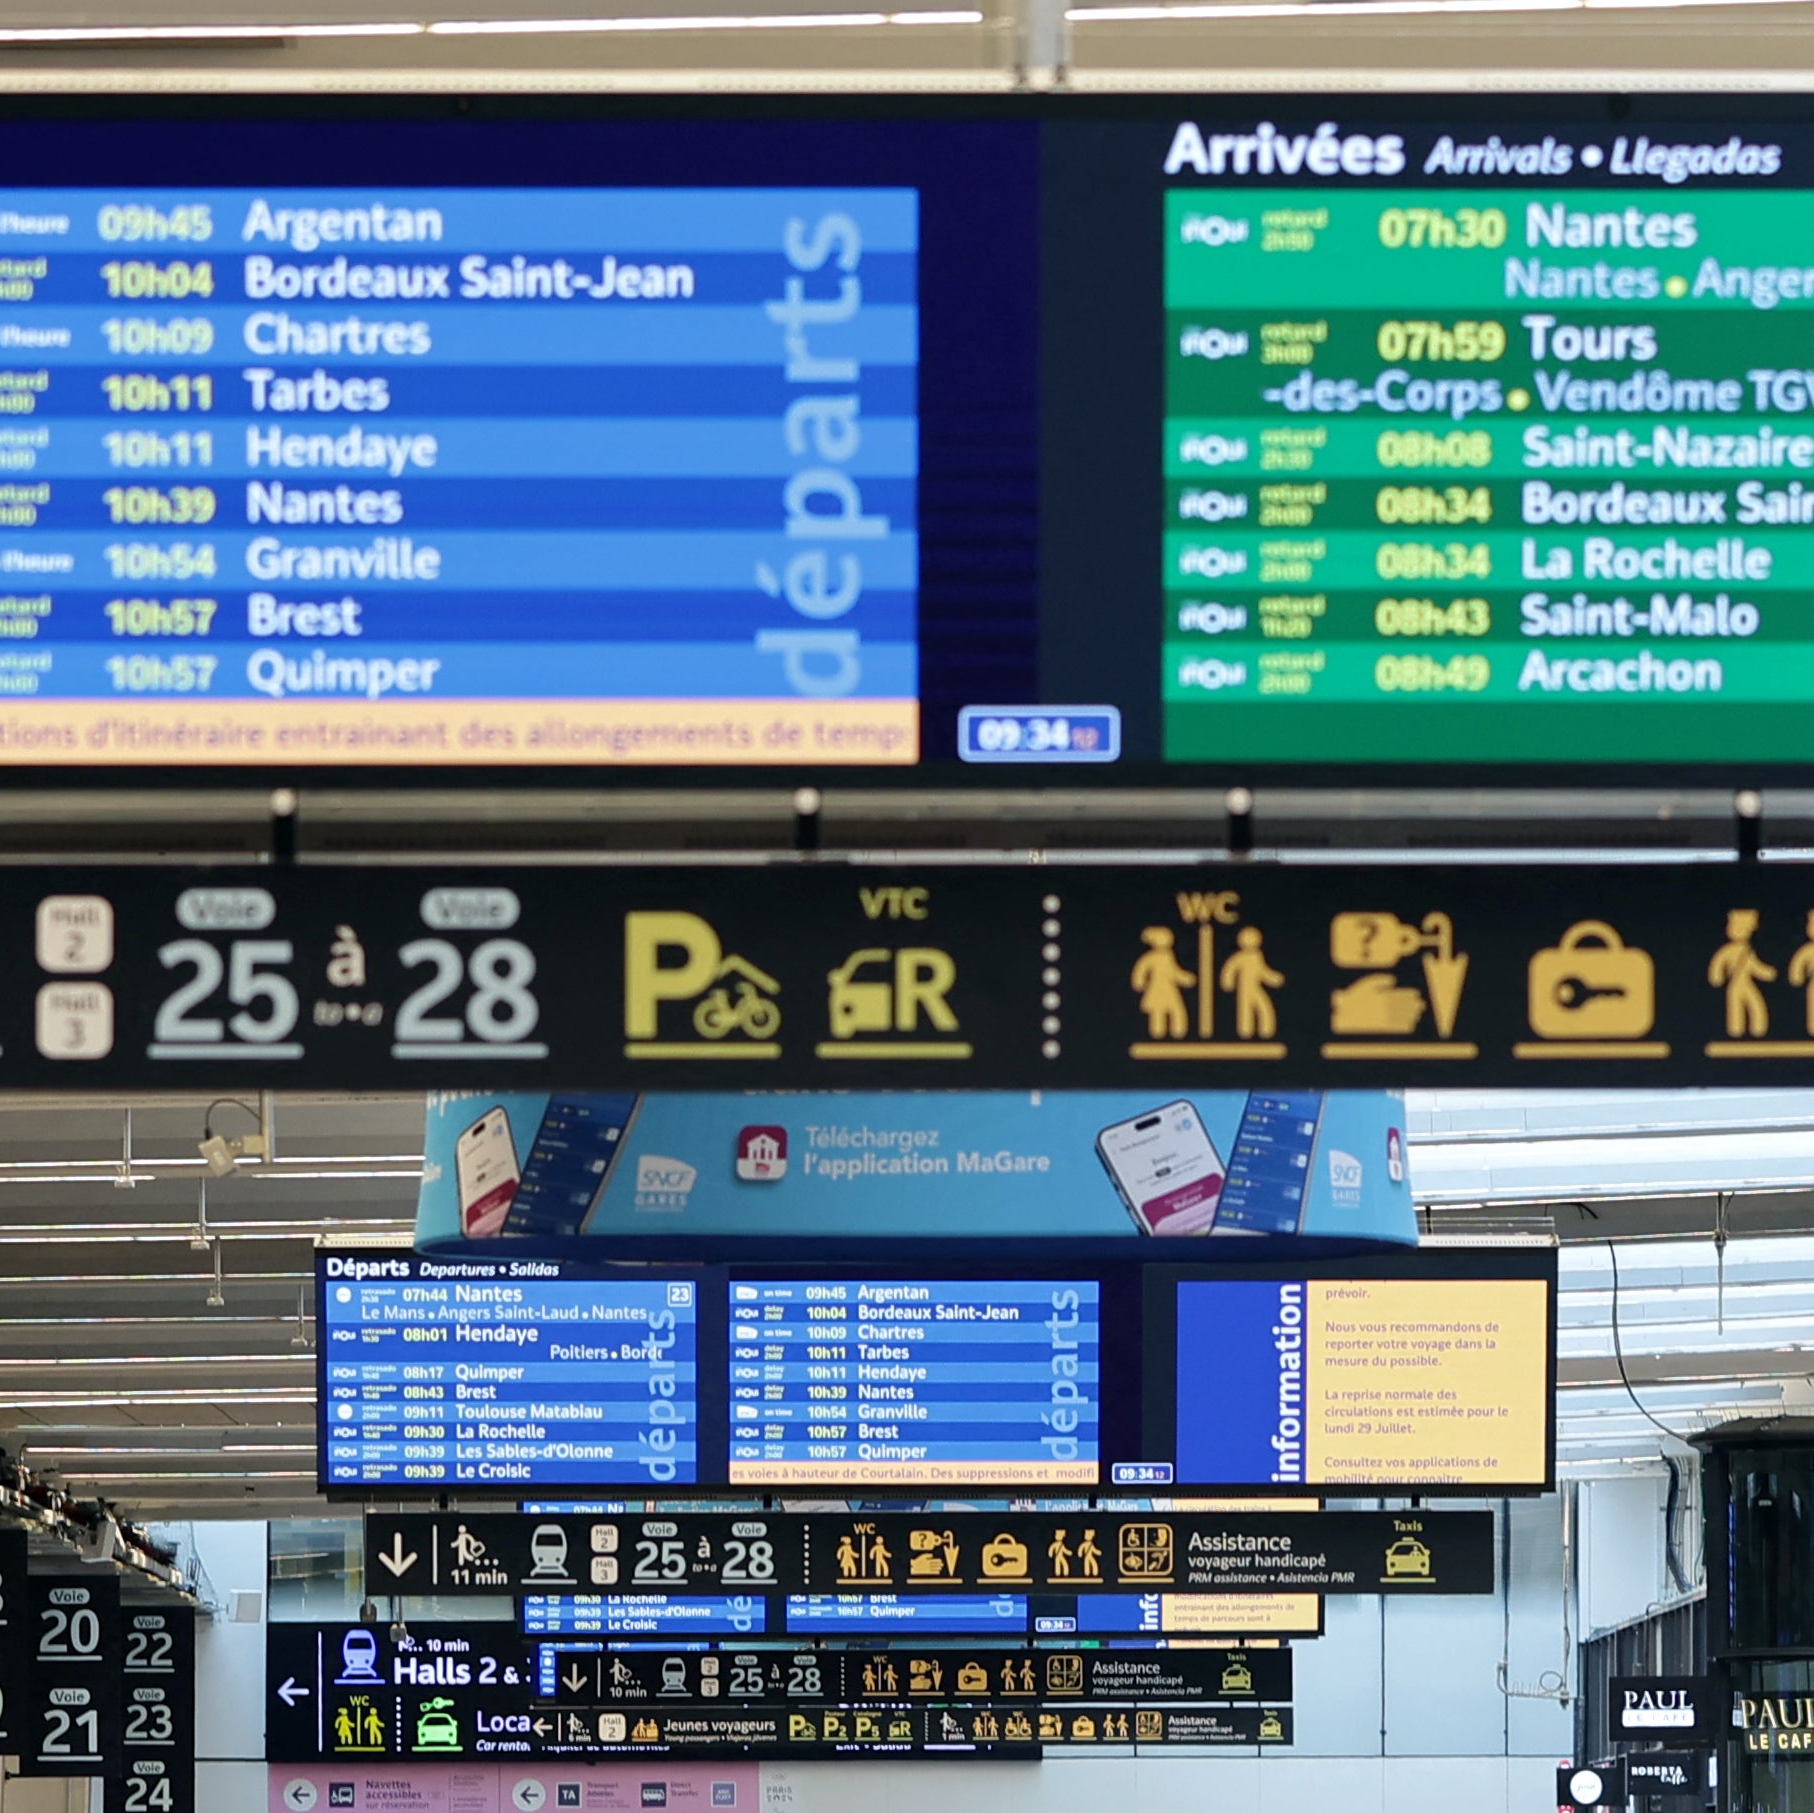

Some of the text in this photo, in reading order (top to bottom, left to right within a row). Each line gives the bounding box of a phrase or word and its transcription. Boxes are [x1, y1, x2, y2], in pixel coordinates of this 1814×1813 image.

[1163, 121, 1780, 184] Arrivées Arrivals Llegadas
[243, 198, 443, 251] Argentan
[1524, 202, 1696, 248] Nantes
[243, 255, 694, 300] Bordeaux Saint-Jean
[1504, 257, 1660, 298] Nantes
[243, 312, 431, 355] Chartres
[1522, 314, 1657, 361] Tours
[243, 368, 390, 412] Tarbes
[1263, 370, 1502, 421] -des-Corps
[1531, 369, 1742, 413] Vendôme
[245, 425, 437, 477] Hendaye
[754, 212, 890, 698] départs
[246, 481, 403, 524] Nantes
[1521, 480, 1727, 524] Bordeaux
[246, 537, 441, 580] Granville
[1521, 537, 1773, 580] La Rochelle
[247, 593, 362, 636] Brest
[1519, 592, 1761, 636] Saint-Malo
[247, 648, 440, 700] Quimper
[1518, 648, 1722, 692] Arcachon
[860, 889, 928, 920] VTC
[1178, 893, 1239, 924] WC
[155, 926, 538, 1042] 25 à 28
[805, 1124, 939, 1155] Téléchargez
[804, 1149, 1050, 1179] l'application MaGare
[327, 1259, 559, 1280] Départs Departures Salidas
[456, 1286, 522, 1302] Nantes
[456, 1325, 538, 1344] Hendaye
[1325, 1339, 1482, 1351] reporter votre voyage dans
[1390, 1322, 1499, 1333] recommandons de
[1272, 1284, 1301, 1482] information
[1325, 1405, 1493, 1419] circulations est estimée pour
[1325, 1423, 1415, 1434] lundi 29 Juillet.
[635, 1536, 774, 1578] 25 à 28
[1188, 1553, 1326, 1570] voyageur handicapé
[1189, 1532, 1291, 1550] Assistance
[451, 1569, 507, 1585] 11 min
[39, 1609, 100, 1654] 20
[125, 1633, 173, 1666] 22
[394, 1657, 519, 1685] Halls 2 &
[1624, 1690, 1693, 1710] PAUL
[42, 1710, 98, 1753] 21
[125, 1705, 173, 1739] 23
[664, 1719, 775, 1735] Jeunes voyageurs
[1749, 1735, 1769, 1750] LE
[1631, 1766, 1684, 1777] ROBERTA
[125, 1777, 173, 1812] 24
